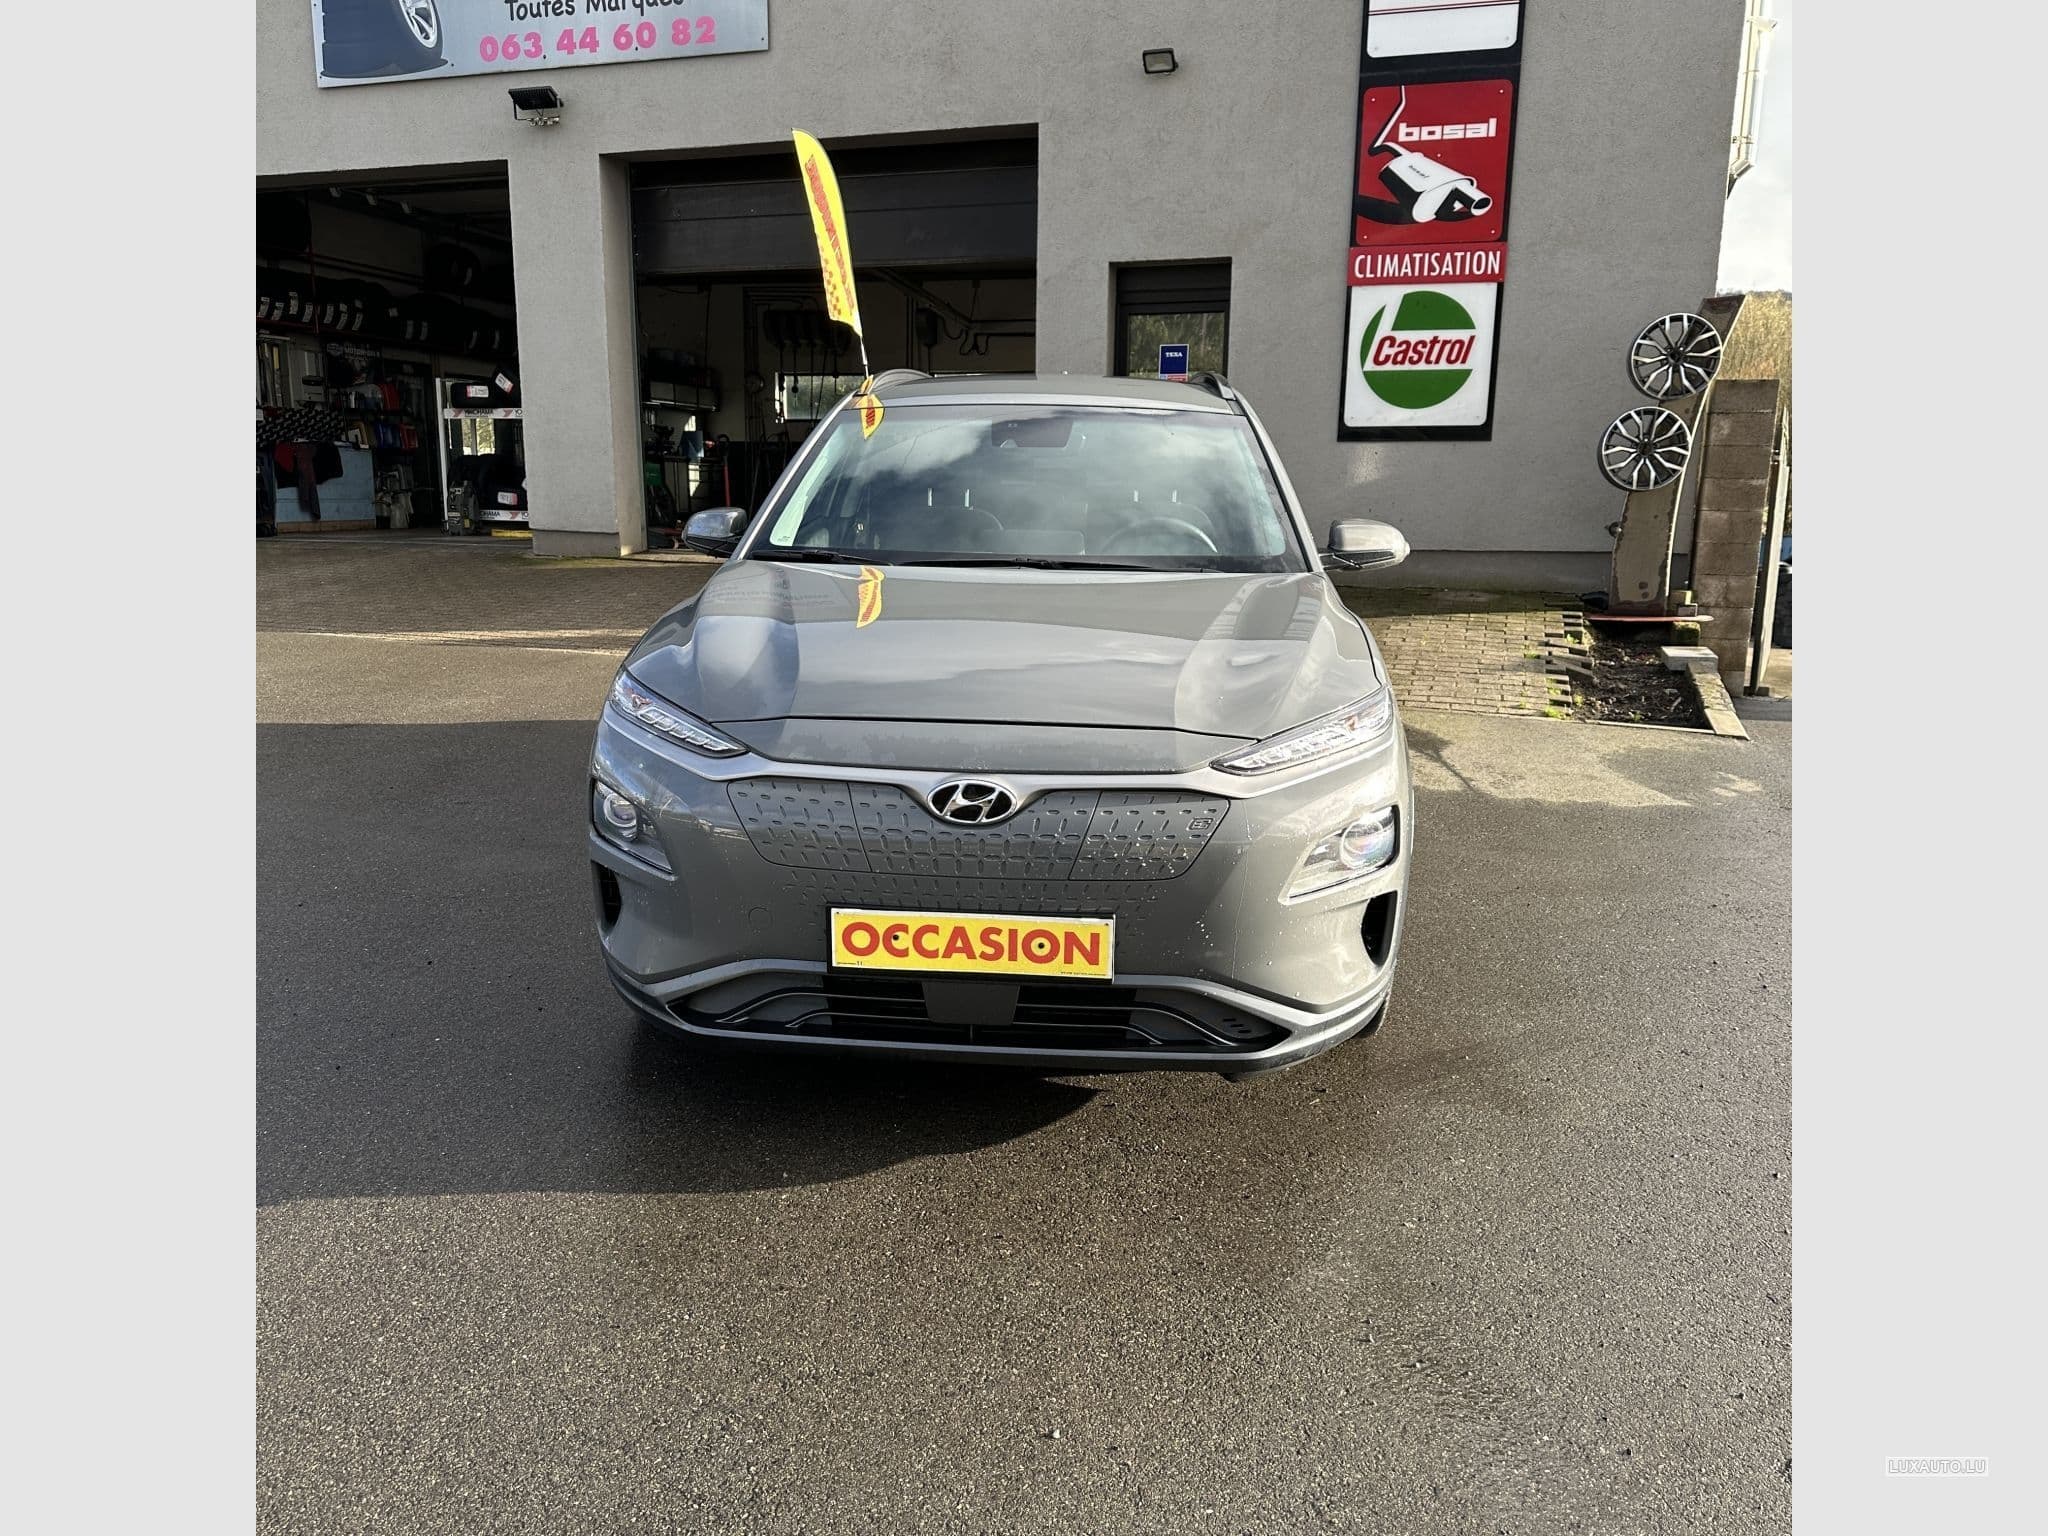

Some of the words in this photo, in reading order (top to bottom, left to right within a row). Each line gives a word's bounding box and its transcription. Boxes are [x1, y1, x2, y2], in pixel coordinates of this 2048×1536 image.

[504, 0, 576, 21] Toutes
[480, 31, 543, 62] 063
[556, 26, 600, 55] 44
[613, 21, 657, 51] 60
[671, 16, 716, 46] 82
[1398, 118, 1497, 142] bosal
[1354, 250, 1501, 278] CLIMATISATION
[1373, 334, 1476, 366] Castrol
[842, 921, 1101, 966] OCCASION
